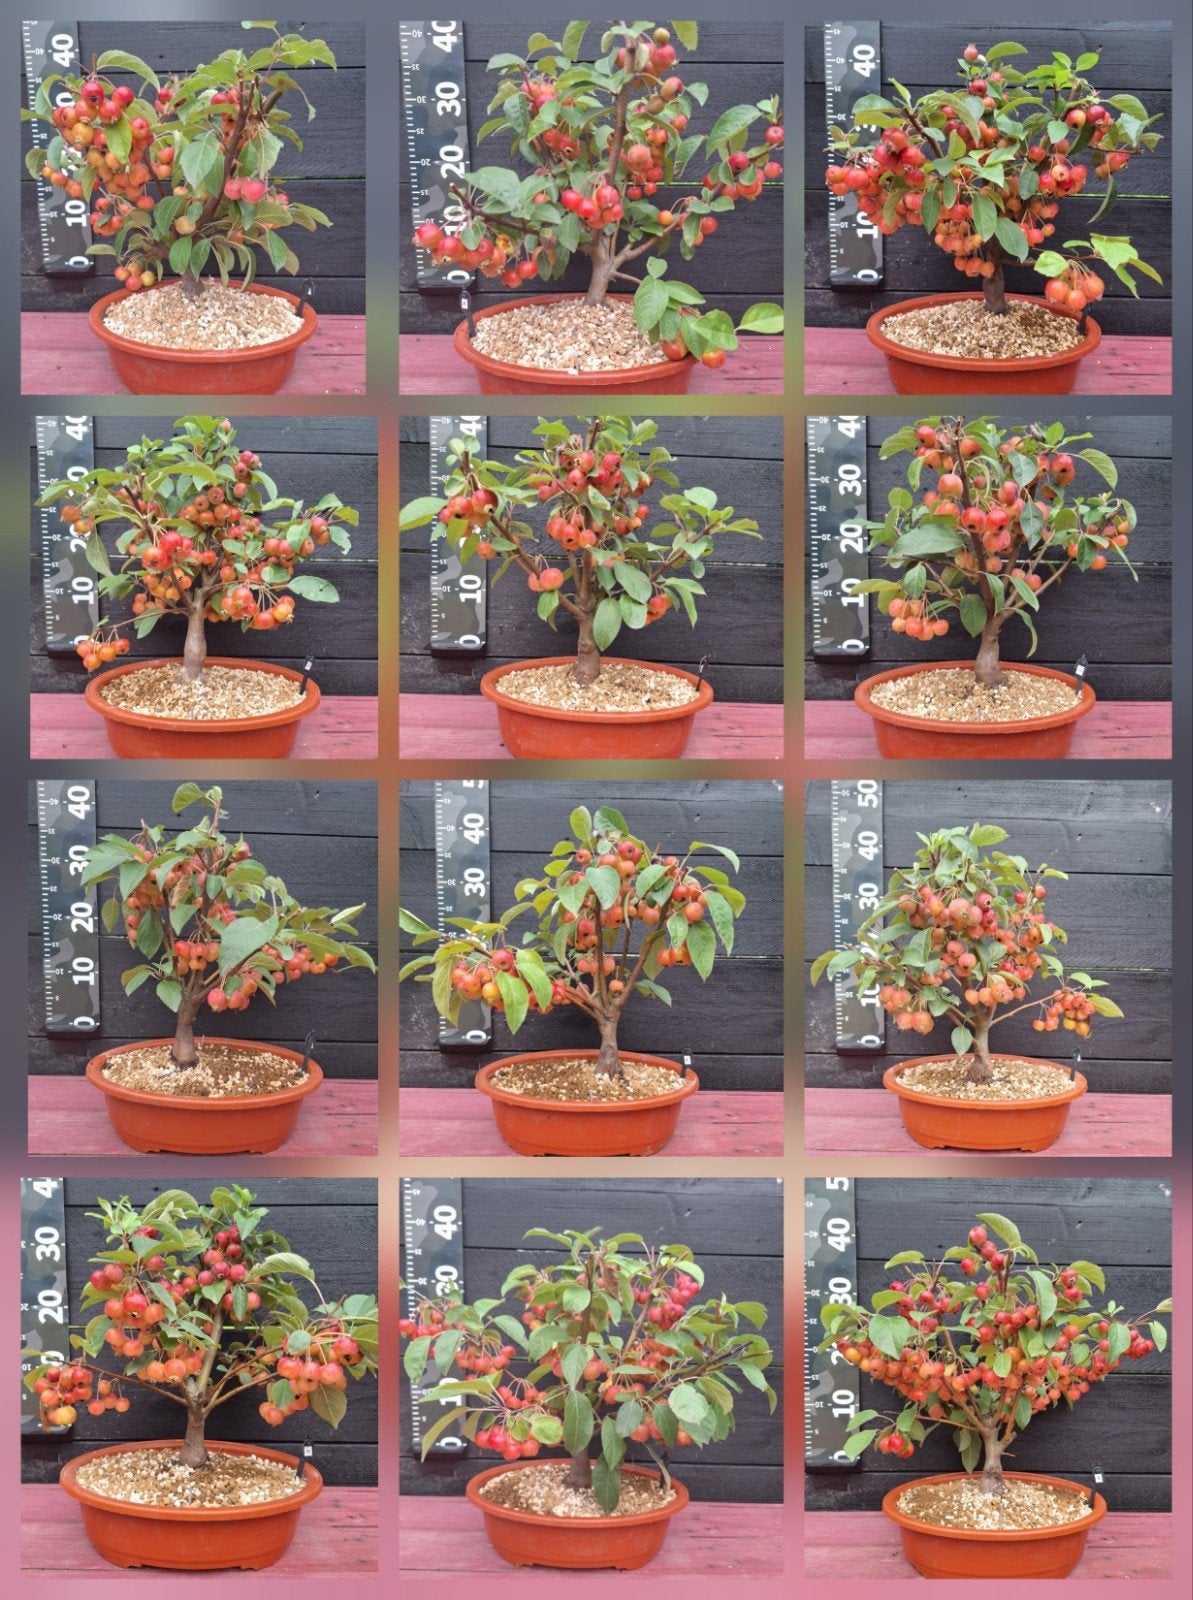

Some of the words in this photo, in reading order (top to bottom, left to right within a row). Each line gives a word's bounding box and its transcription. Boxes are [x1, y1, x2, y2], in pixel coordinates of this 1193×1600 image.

[52, 34, 74, 67] 40
[431, 21, 458, 53] 40
[853, 45, 876, 77] 40
[436, 82, 461, 116] 30
[439, 145, 466, 179] 20
[65, 200, 86, 227] 10
[856, 211, 878, 238] 10
[69, 256, 88, 267] 0
[447, 270, 470, 282] 0
[857, 270, 878, 282] 0
[838, 416, 861, 439] 4
[838, 464, 862, 497] 30
[840, 524, 863, 554] 20
[72, 577, 94, 605] 10
[460, 575, 482, 603] 10
[841, 578, 864, 607] 10
[459, 634, 480, 646] 0
[843, 639, 864, 652] 0
[67, 786, 90, 820] 40
[857, 780, 878, 808] 50
[463, 813, 486, 844] 40
[69, 845, 90, 875] 30
[858, 831, 878, 861] 40
[464, 868, 486, 897] 30
[859, 882, 879, 910] 30
[71, 902, 93, 933] 20
[72, 957, 95, 986] 10
[861, 983, 881, 1008] 10
[74, 1016, 96, 1028] 0
[466, 1030, 487, 1042] 0
[861, 1035, 880, 1047] 0
[33, 1178, 58, 1199] 4
[826, 1176, 849, 1192] 5
[433, 1205, 458, 1241] 40
[827, 1217, 851, 1252] 40
[35, 1226, 61, 1262] 30
[435, 1265, 458, 1297] 30
[829, 1277, 852, 1305] 30
[38, 1289, 63, 1324] 20
[833, 1389, 855, 1418] 10
[440, 1437, 462, 1450] 0
